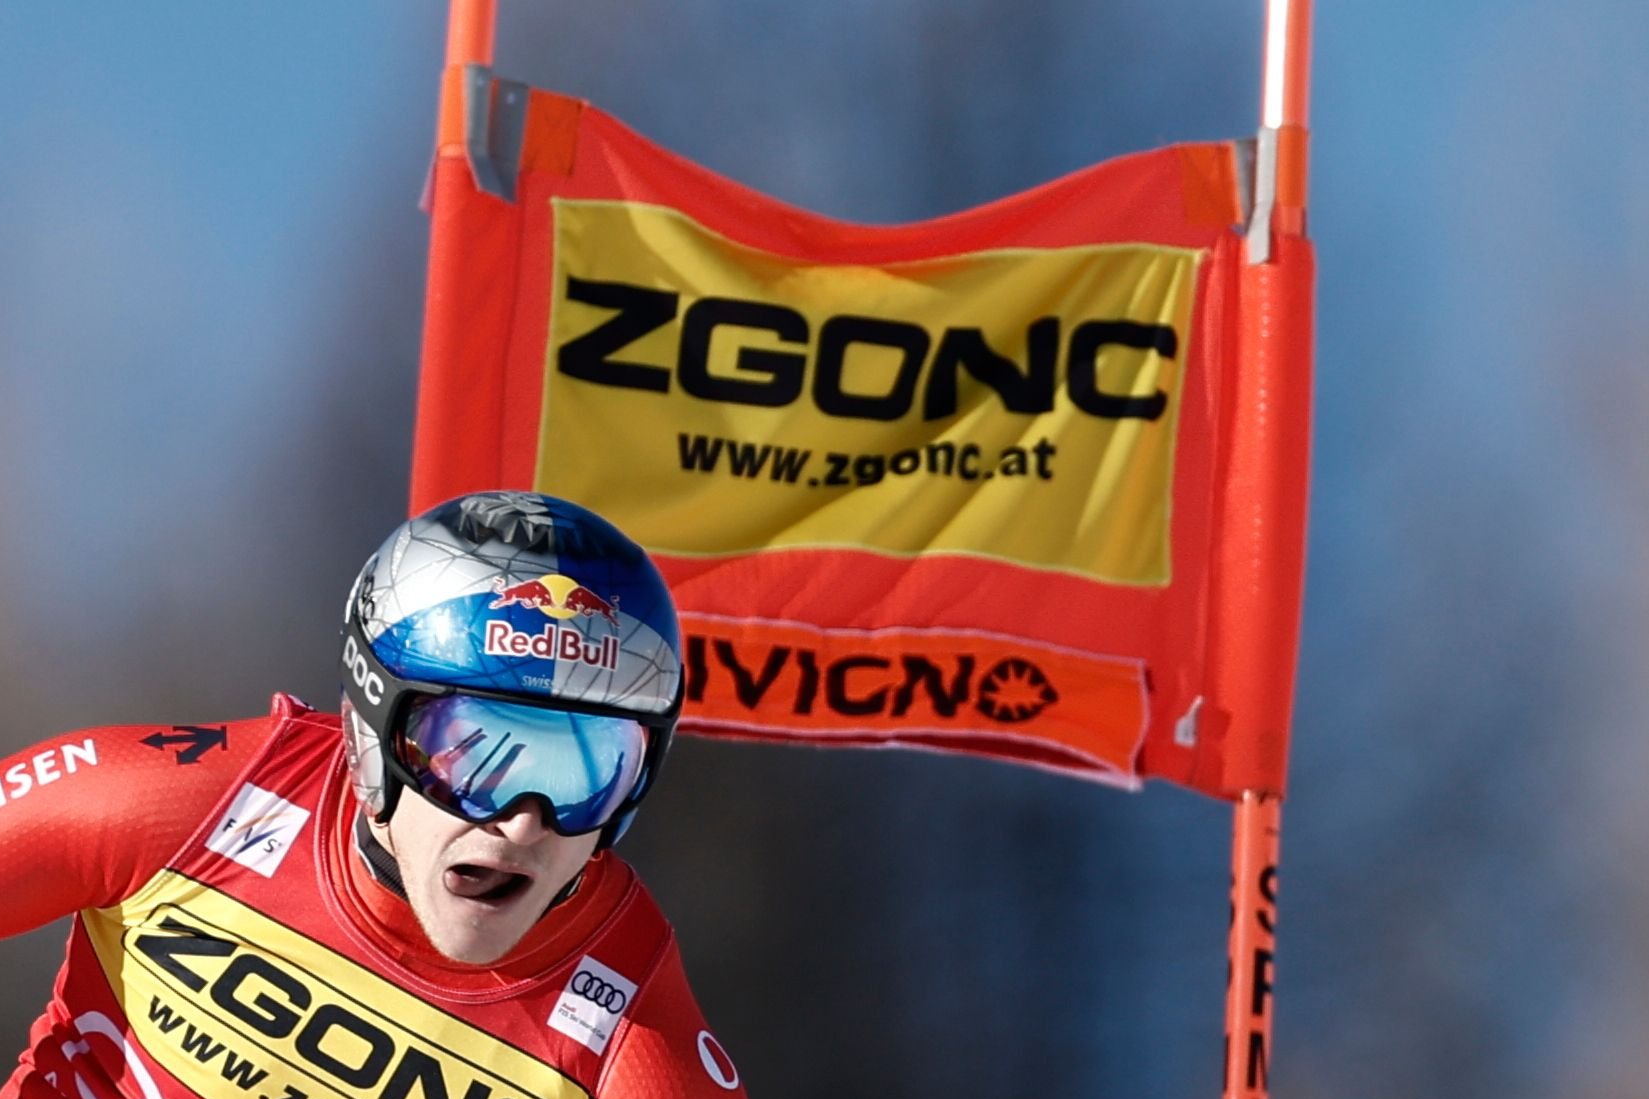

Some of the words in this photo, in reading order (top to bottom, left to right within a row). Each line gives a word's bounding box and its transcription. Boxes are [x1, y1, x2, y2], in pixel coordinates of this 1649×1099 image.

[557, 275, 1178, 422] ZGONC
[677, 431, 1058, 488] www.zgonc.at
[485, 621, 555, 659] Red
[558, 627, 619, 671] Bull
[683, 635, 1058, 724] IVIGNO
